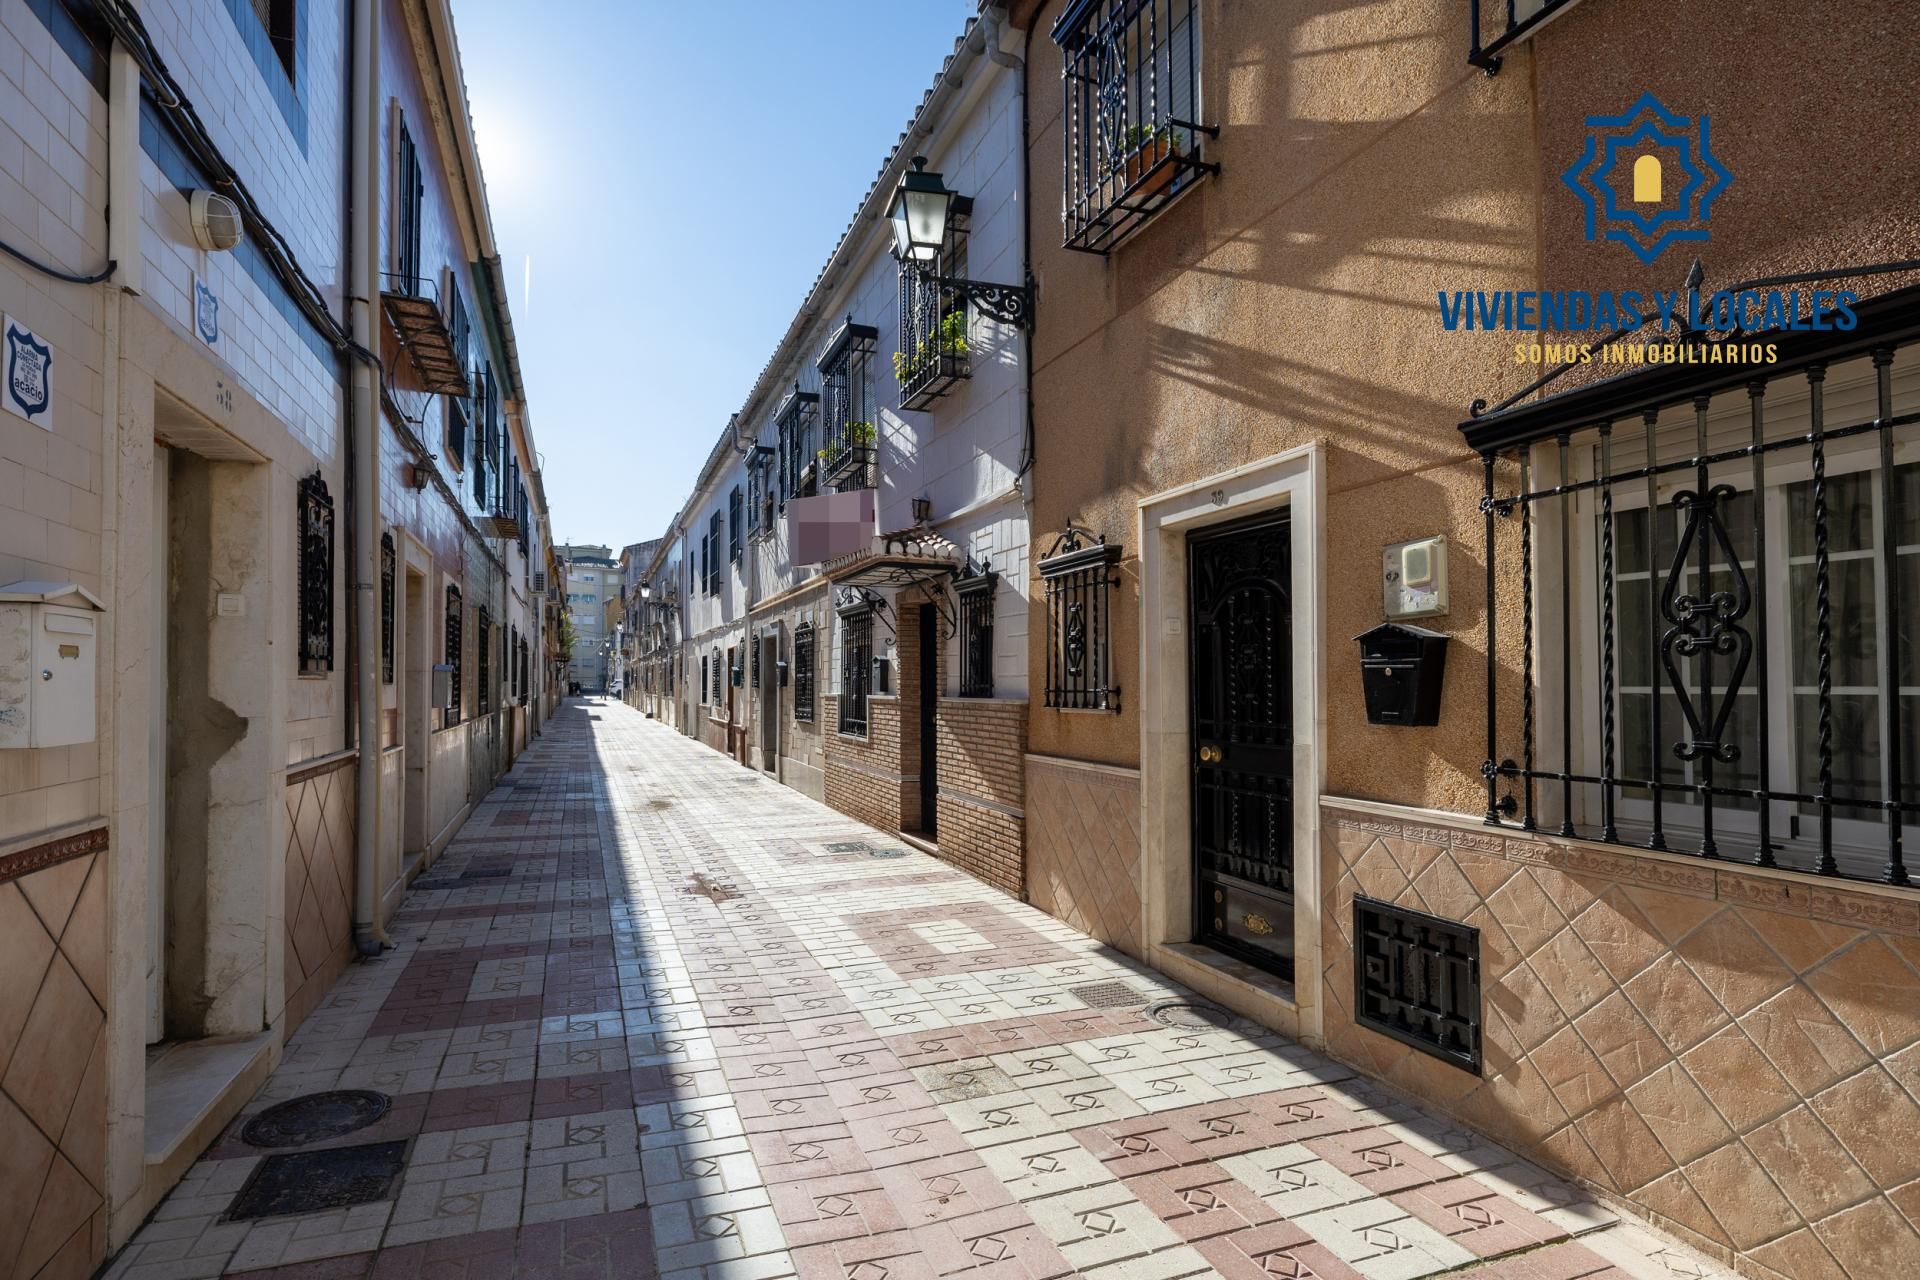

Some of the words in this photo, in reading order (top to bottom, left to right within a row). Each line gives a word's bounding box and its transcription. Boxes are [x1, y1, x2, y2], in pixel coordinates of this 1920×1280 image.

[16, 350, 42, 371] CONECTADA
[20, 345, 38, 362] ALARMA
[14, 377, 43, 401] acacio
